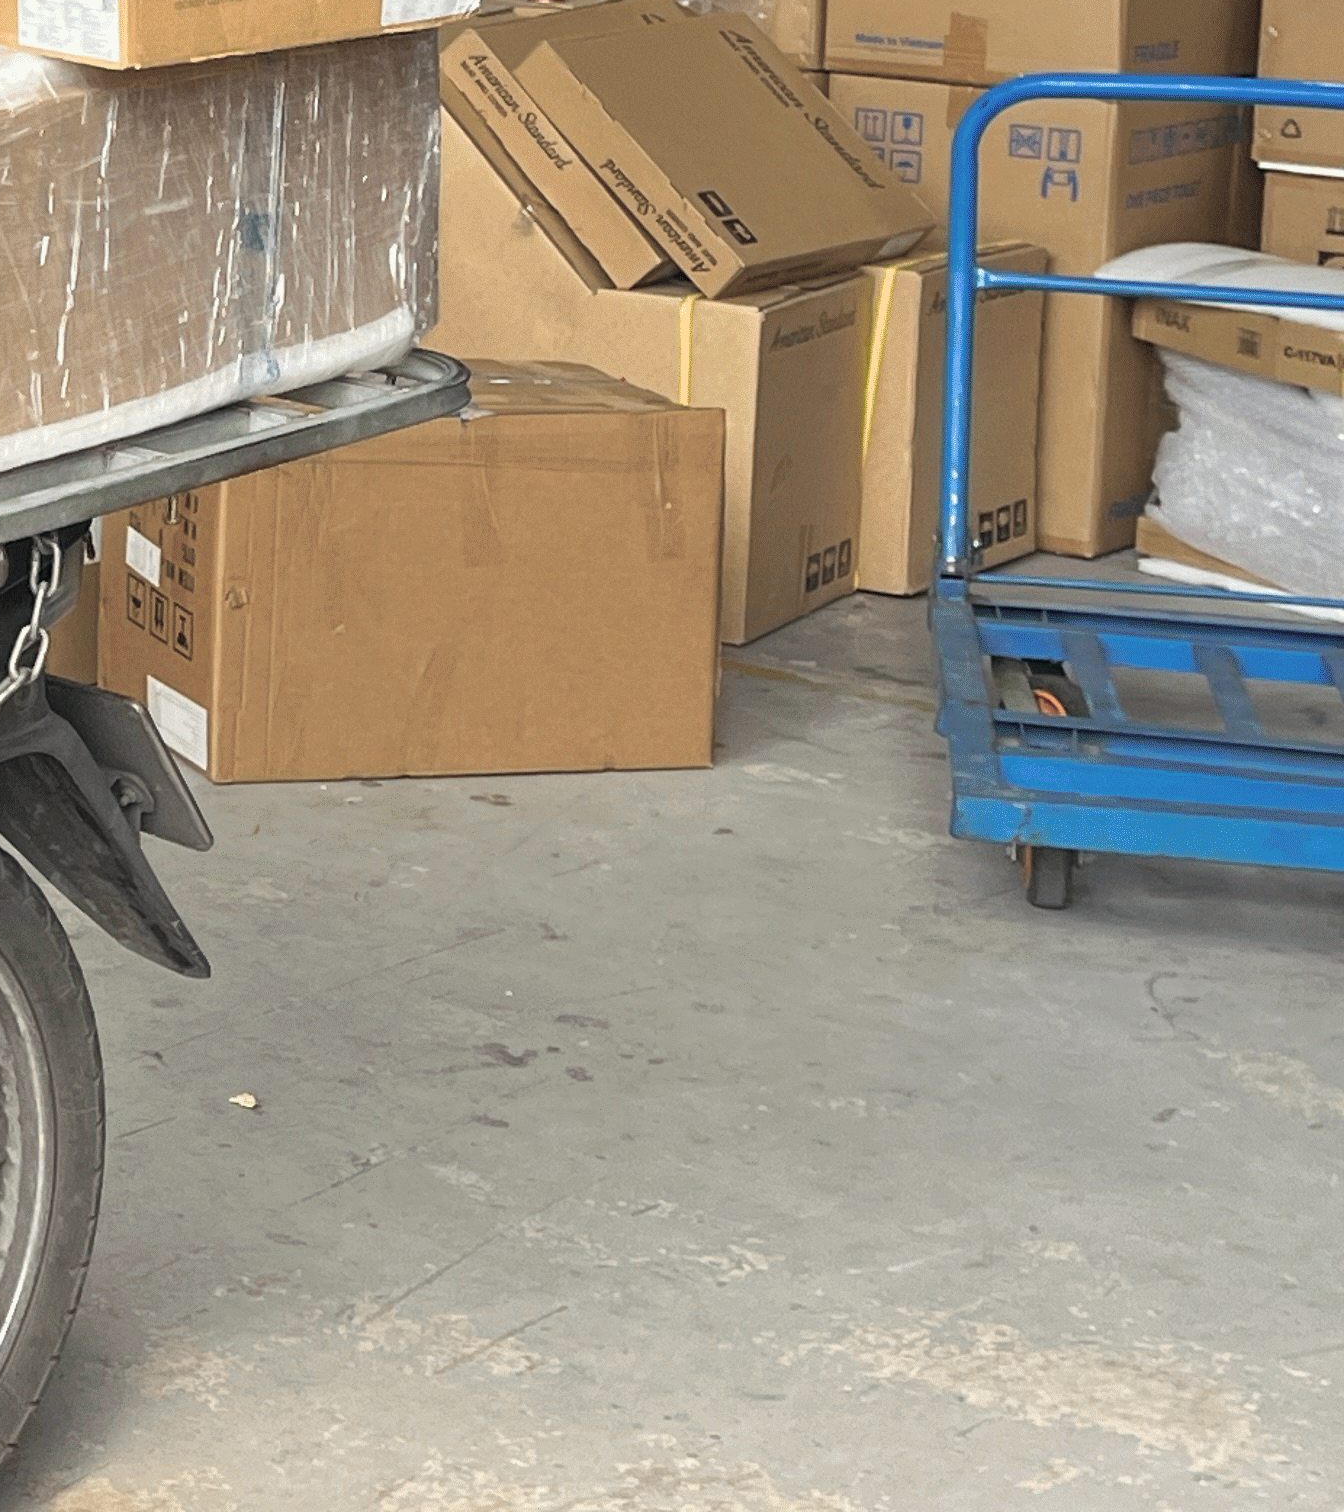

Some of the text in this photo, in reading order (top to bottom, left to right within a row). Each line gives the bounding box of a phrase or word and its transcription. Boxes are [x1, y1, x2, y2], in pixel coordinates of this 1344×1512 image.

[467, 54, 573, 172] American Standard
[725, 28, 887, 192] American Standard
[599, 157, 711, 274] American Standard
